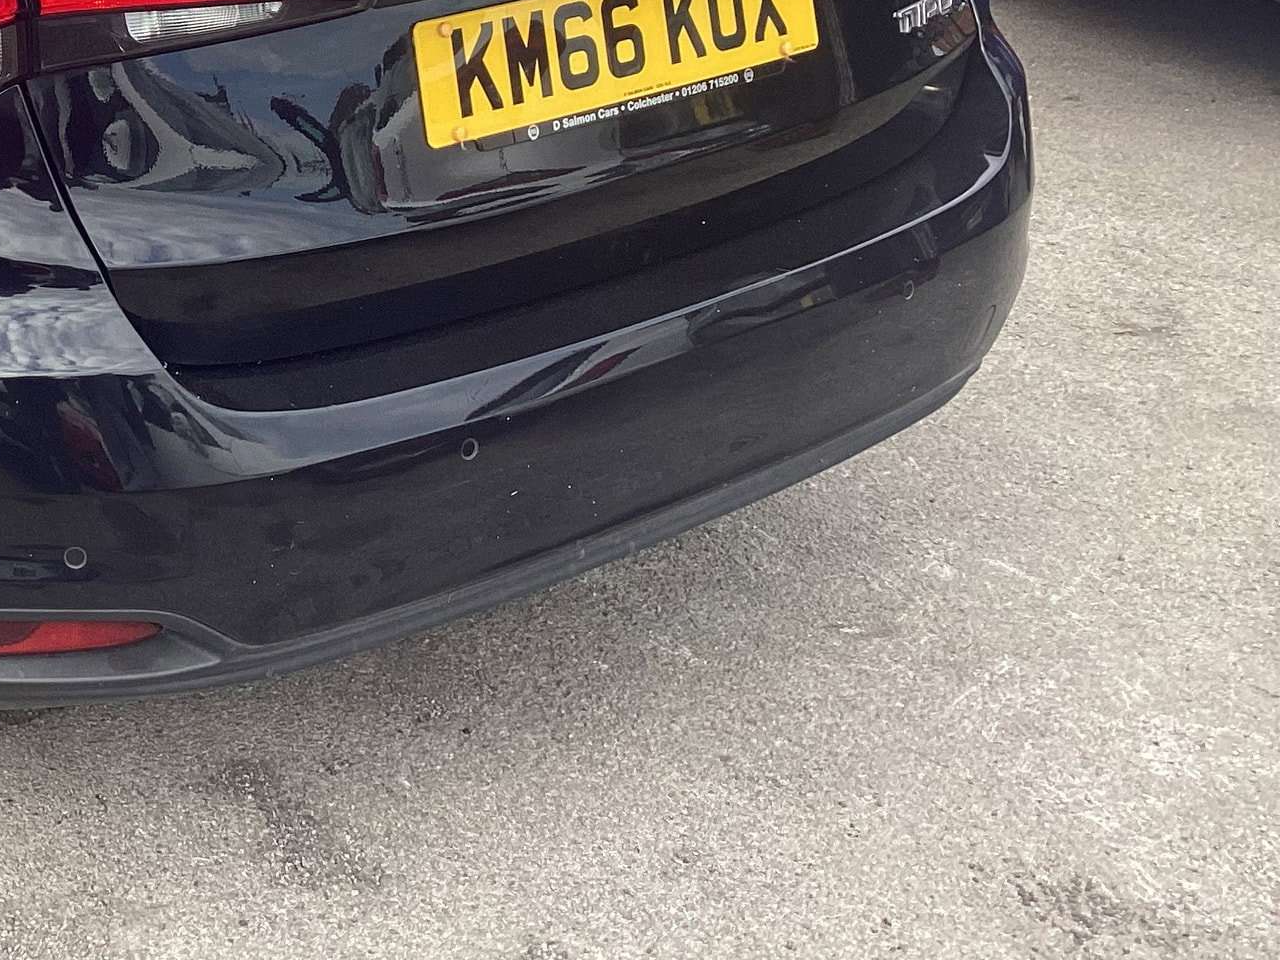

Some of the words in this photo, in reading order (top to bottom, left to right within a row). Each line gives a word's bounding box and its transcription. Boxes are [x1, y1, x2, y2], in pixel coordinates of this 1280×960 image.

[553, 120, 561, 132] D
[563, 112, 597, 129] Salmon
[598, 106, 619, 120] Cars
[627, 92, 674, 112] Colchester
[681, 82, 708, 98] 01206
[709, 73, 739, 90] 715200
